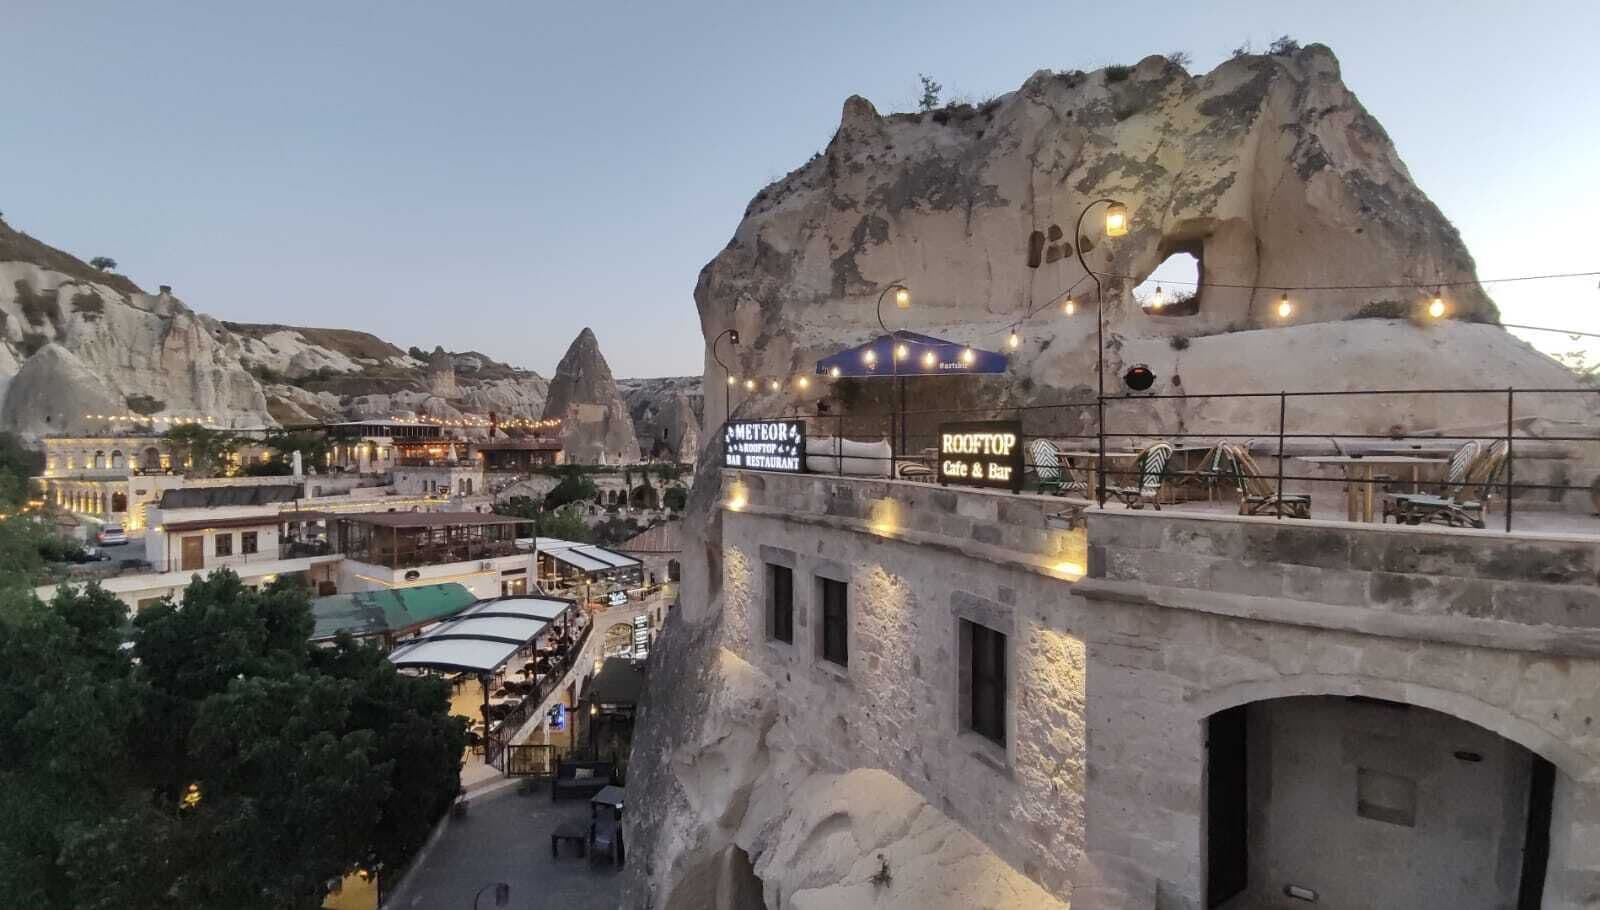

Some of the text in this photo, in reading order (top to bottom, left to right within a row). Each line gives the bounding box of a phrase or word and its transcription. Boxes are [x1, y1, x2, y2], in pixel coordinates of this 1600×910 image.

[735, 423, 787, 440] METEOR
[743, 443, 777, 454] ROOFTOP
[942, 433, 1016, 455] ROOFTOP
[726, 454, 800, 470] BAR RESTAURANT
[943, 460, 1012, 480] Cafe & Bar
